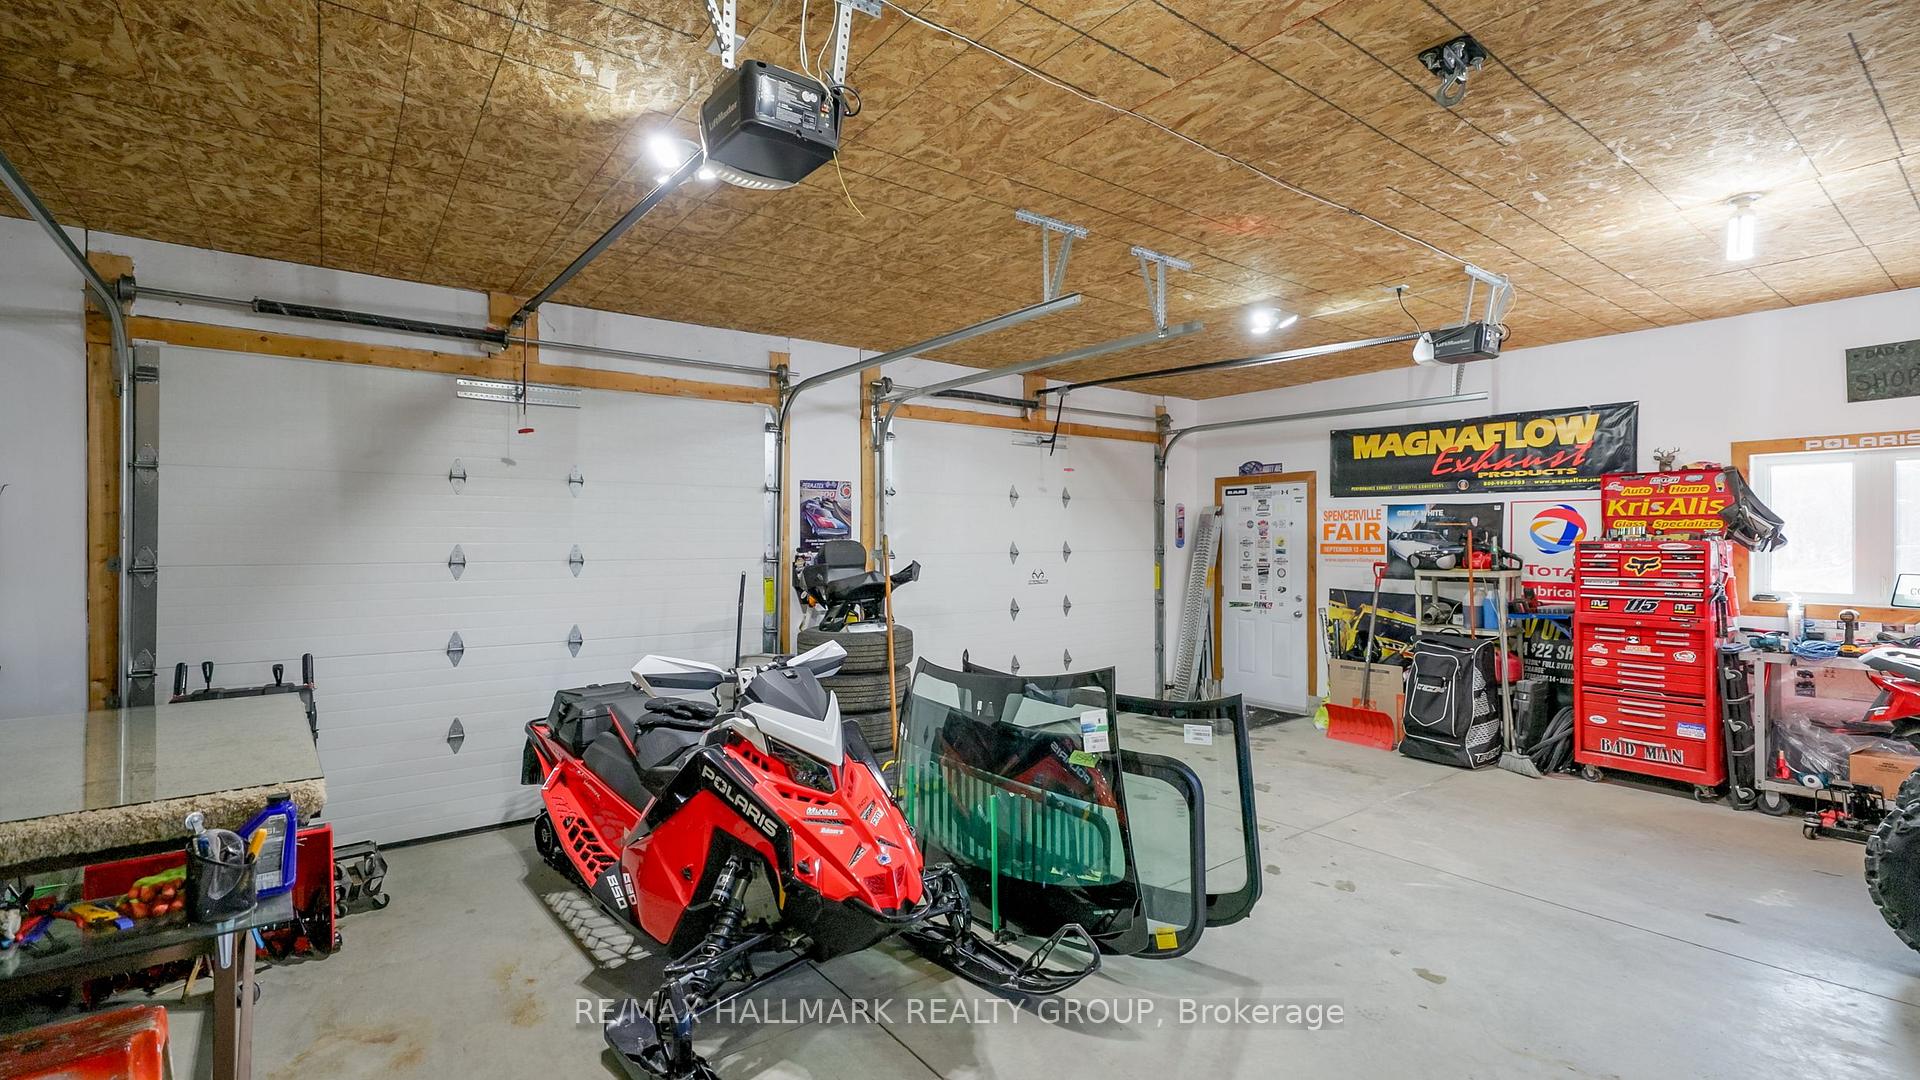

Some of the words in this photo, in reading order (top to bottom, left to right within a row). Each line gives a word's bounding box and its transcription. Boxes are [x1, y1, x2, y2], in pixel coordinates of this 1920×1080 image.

[1855, 367, 1920, 391] SHOP
[1353, 414, 1599, 460] MAGNAFLOW
[1805, 433, 1920, 450] POLARIS
[1431, 440, 1594, 476] Exhaust
[1477, 467, 1578, 479] PRODUCTS
[1622, 487, 1652, 495] Auto
[1670, 485, 1710, 494] Home
[1323, 509, 1381, 521] SPENCERVILLE
[1607, 497, 1725, 516] KrisAlis
[1323, 522, 1381, 541] FAIR
[1613, 520, 1647, 528] Glass
[1653, 519, 1724, 529] Specialists
[1600, 738, 1636, 757] BAD
[1643, 747, 1684, 765] MAN
[701, 764, 779, 838] POLARIS
[606, 875, 629, 910] 850
